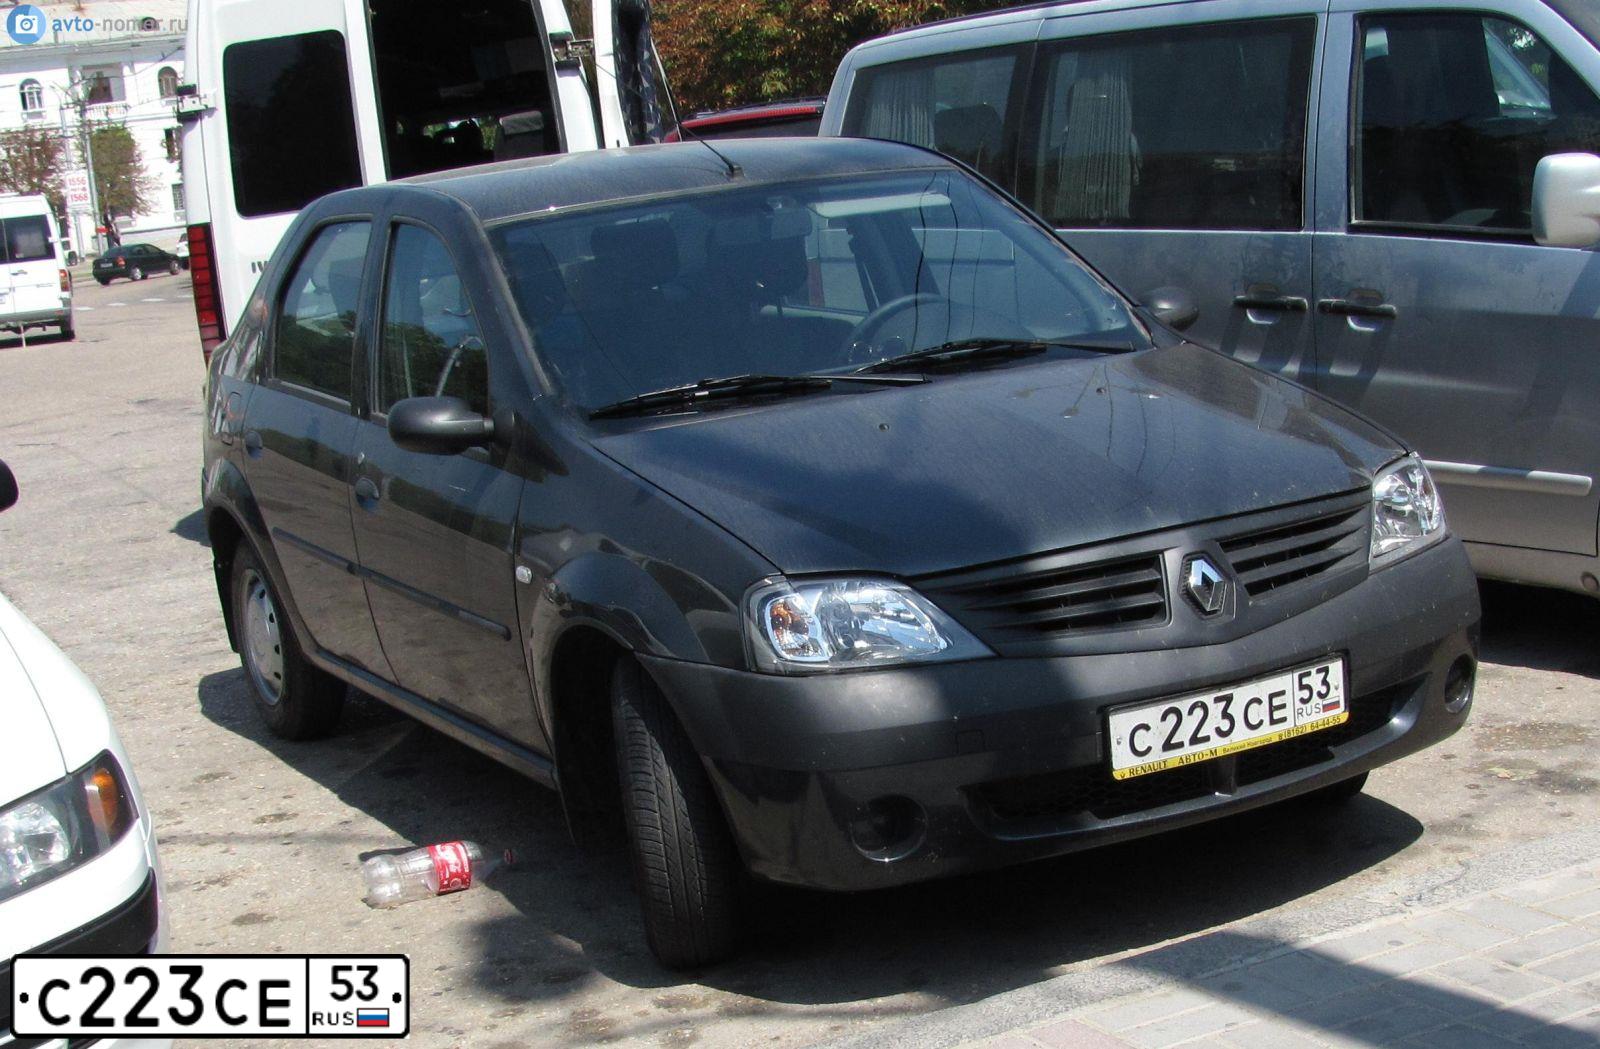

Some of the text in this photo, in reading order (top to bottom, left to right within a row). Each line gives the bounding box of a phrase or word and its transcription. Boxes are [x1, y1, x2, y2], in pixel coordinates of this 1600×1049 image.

[1297, 665, 1331, 705] 53
[1296, 702, 1322, 720] RUS
[1128, 760, 1168, 777] RENAULT
